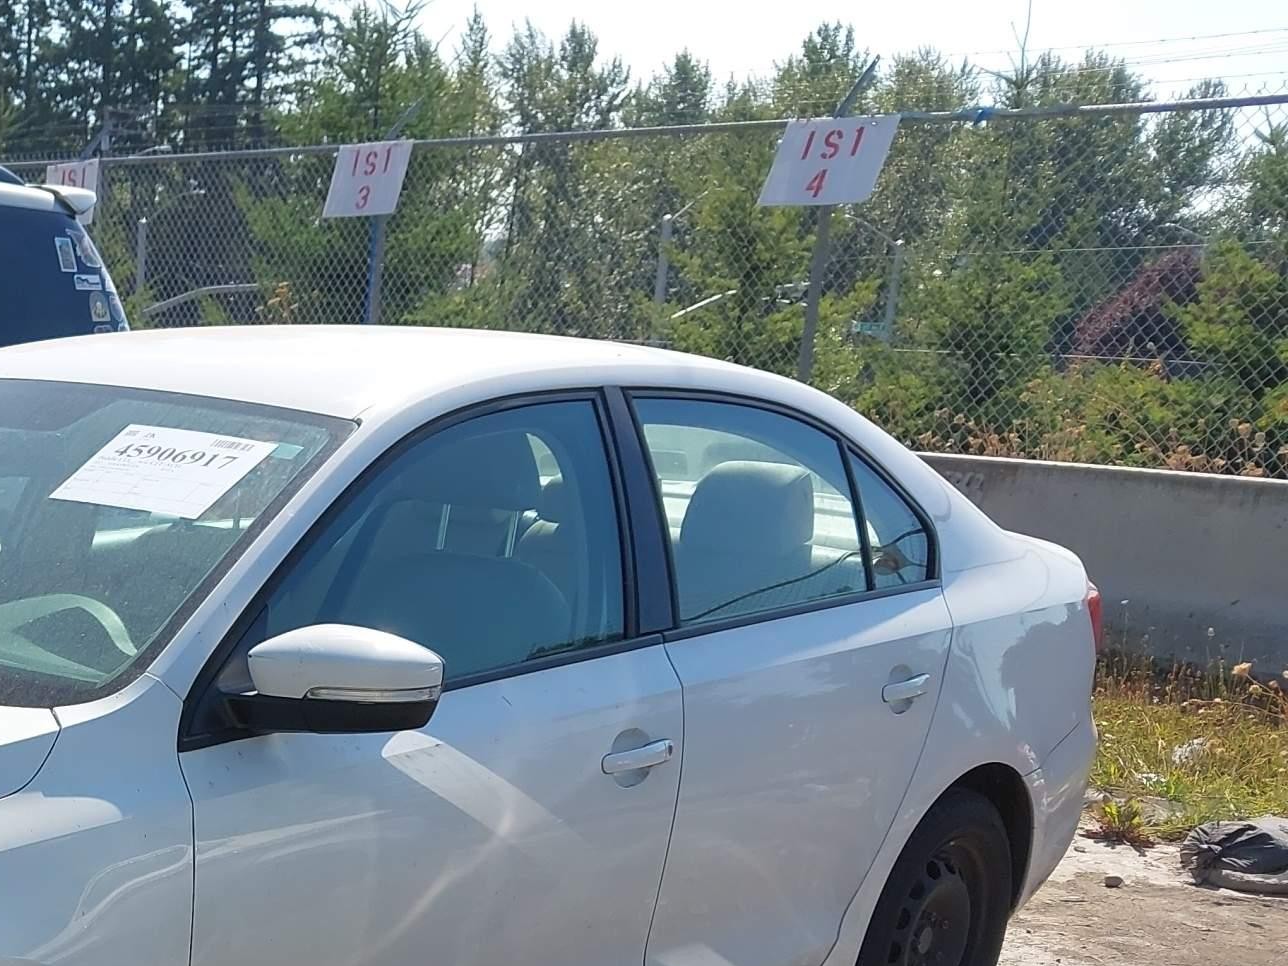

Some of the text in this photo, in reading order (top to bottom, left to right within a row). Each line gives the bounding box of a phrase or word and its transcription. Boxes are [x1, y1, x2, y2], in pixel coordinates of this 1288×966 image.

[805, 168, 828, 198] 4
[355, 185, 370, 209] 3
[114, 443, 239, 470] 45906917
